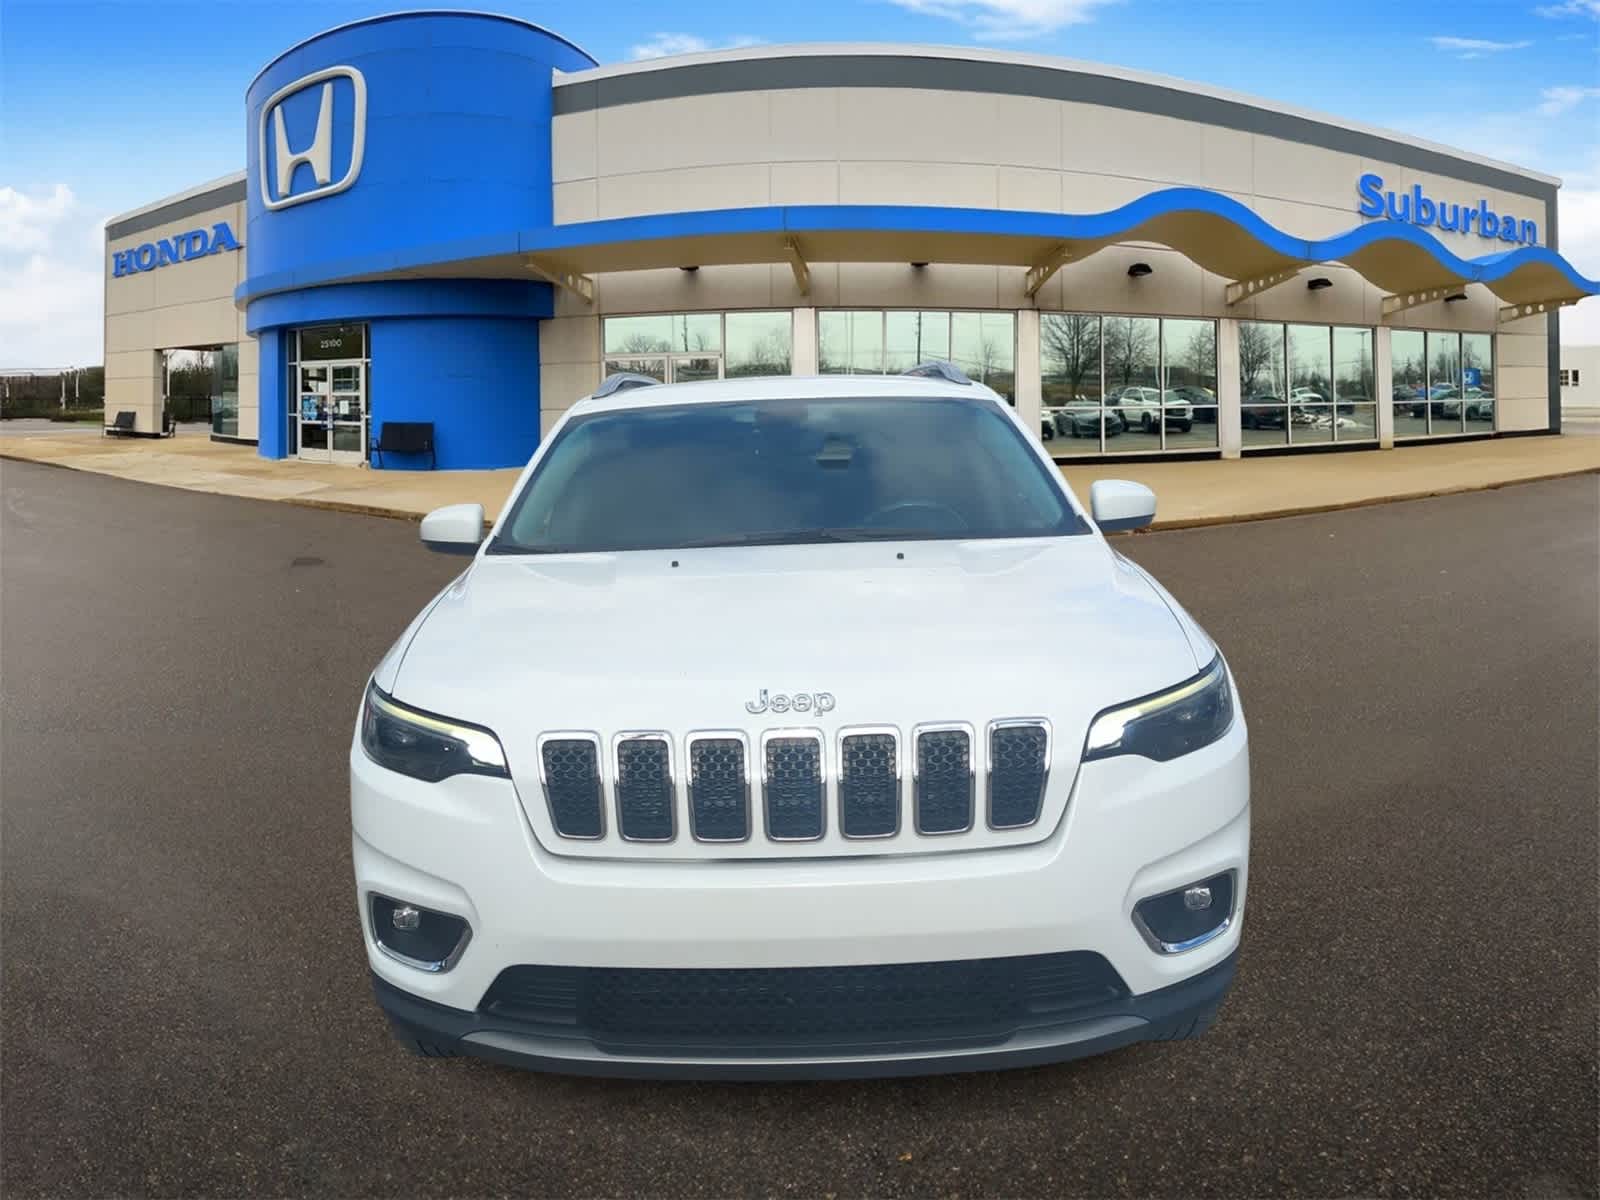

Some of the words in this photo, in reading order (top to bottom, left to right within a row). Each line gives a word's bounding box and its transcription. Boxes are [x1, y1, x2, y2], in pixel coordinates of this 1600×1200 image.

[1358, 173, 1538, 246] Suburban
[112, 221, 240, 278] HONDA
[744, 688, 836, 717] Jeep
